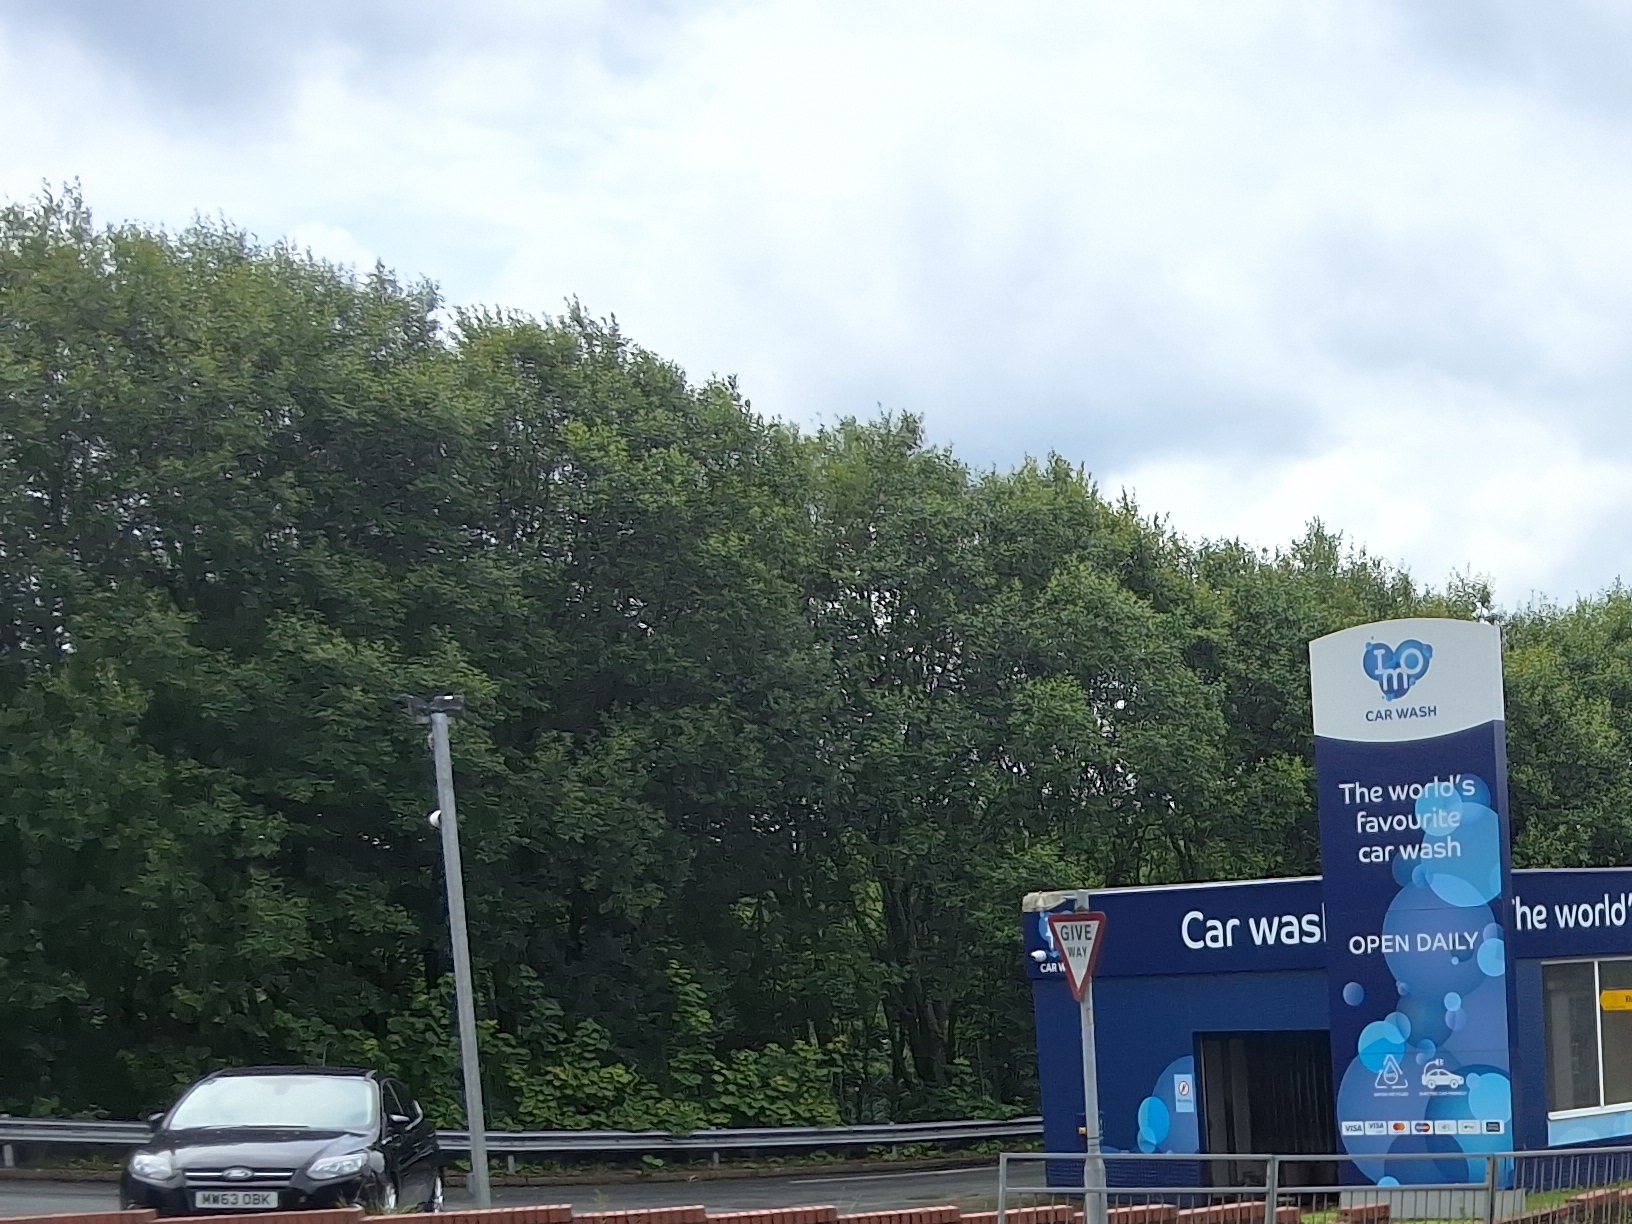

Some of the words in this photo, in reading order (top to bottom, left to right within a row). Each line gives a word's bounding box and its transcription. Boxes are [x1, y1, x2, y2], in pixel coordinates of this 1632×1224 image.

[1365, 709, 1393, 722] CAR
[1396, 705, 1437, 719] WASH
[1338, 781, 1383, 805] The
[1388, 774, 1476, 801] world's
[1356, 808, 1461, 834] favourite
[1358, 844, 1394, 863] car
[1400, 836, 1461, 860] wash
[1511, 895, 1548, 931] he
[1060, 924, 1092, 941] GIVE
[1181, 910, 1241, 949] Car
[1249, 902, 1327, 946] was
[1067, 947, 1087, 958] WAY
[1349, 934, 1410, 955] OPEN
[1416, 931, 1479, 952] DAILY
[1040, 962, 1057, 973] CAR
[1345, 1124, 1363, 1132] VISA
[202, 1193, 239, 1206] MW63
[243, 1193, 271, 1206] OBK
